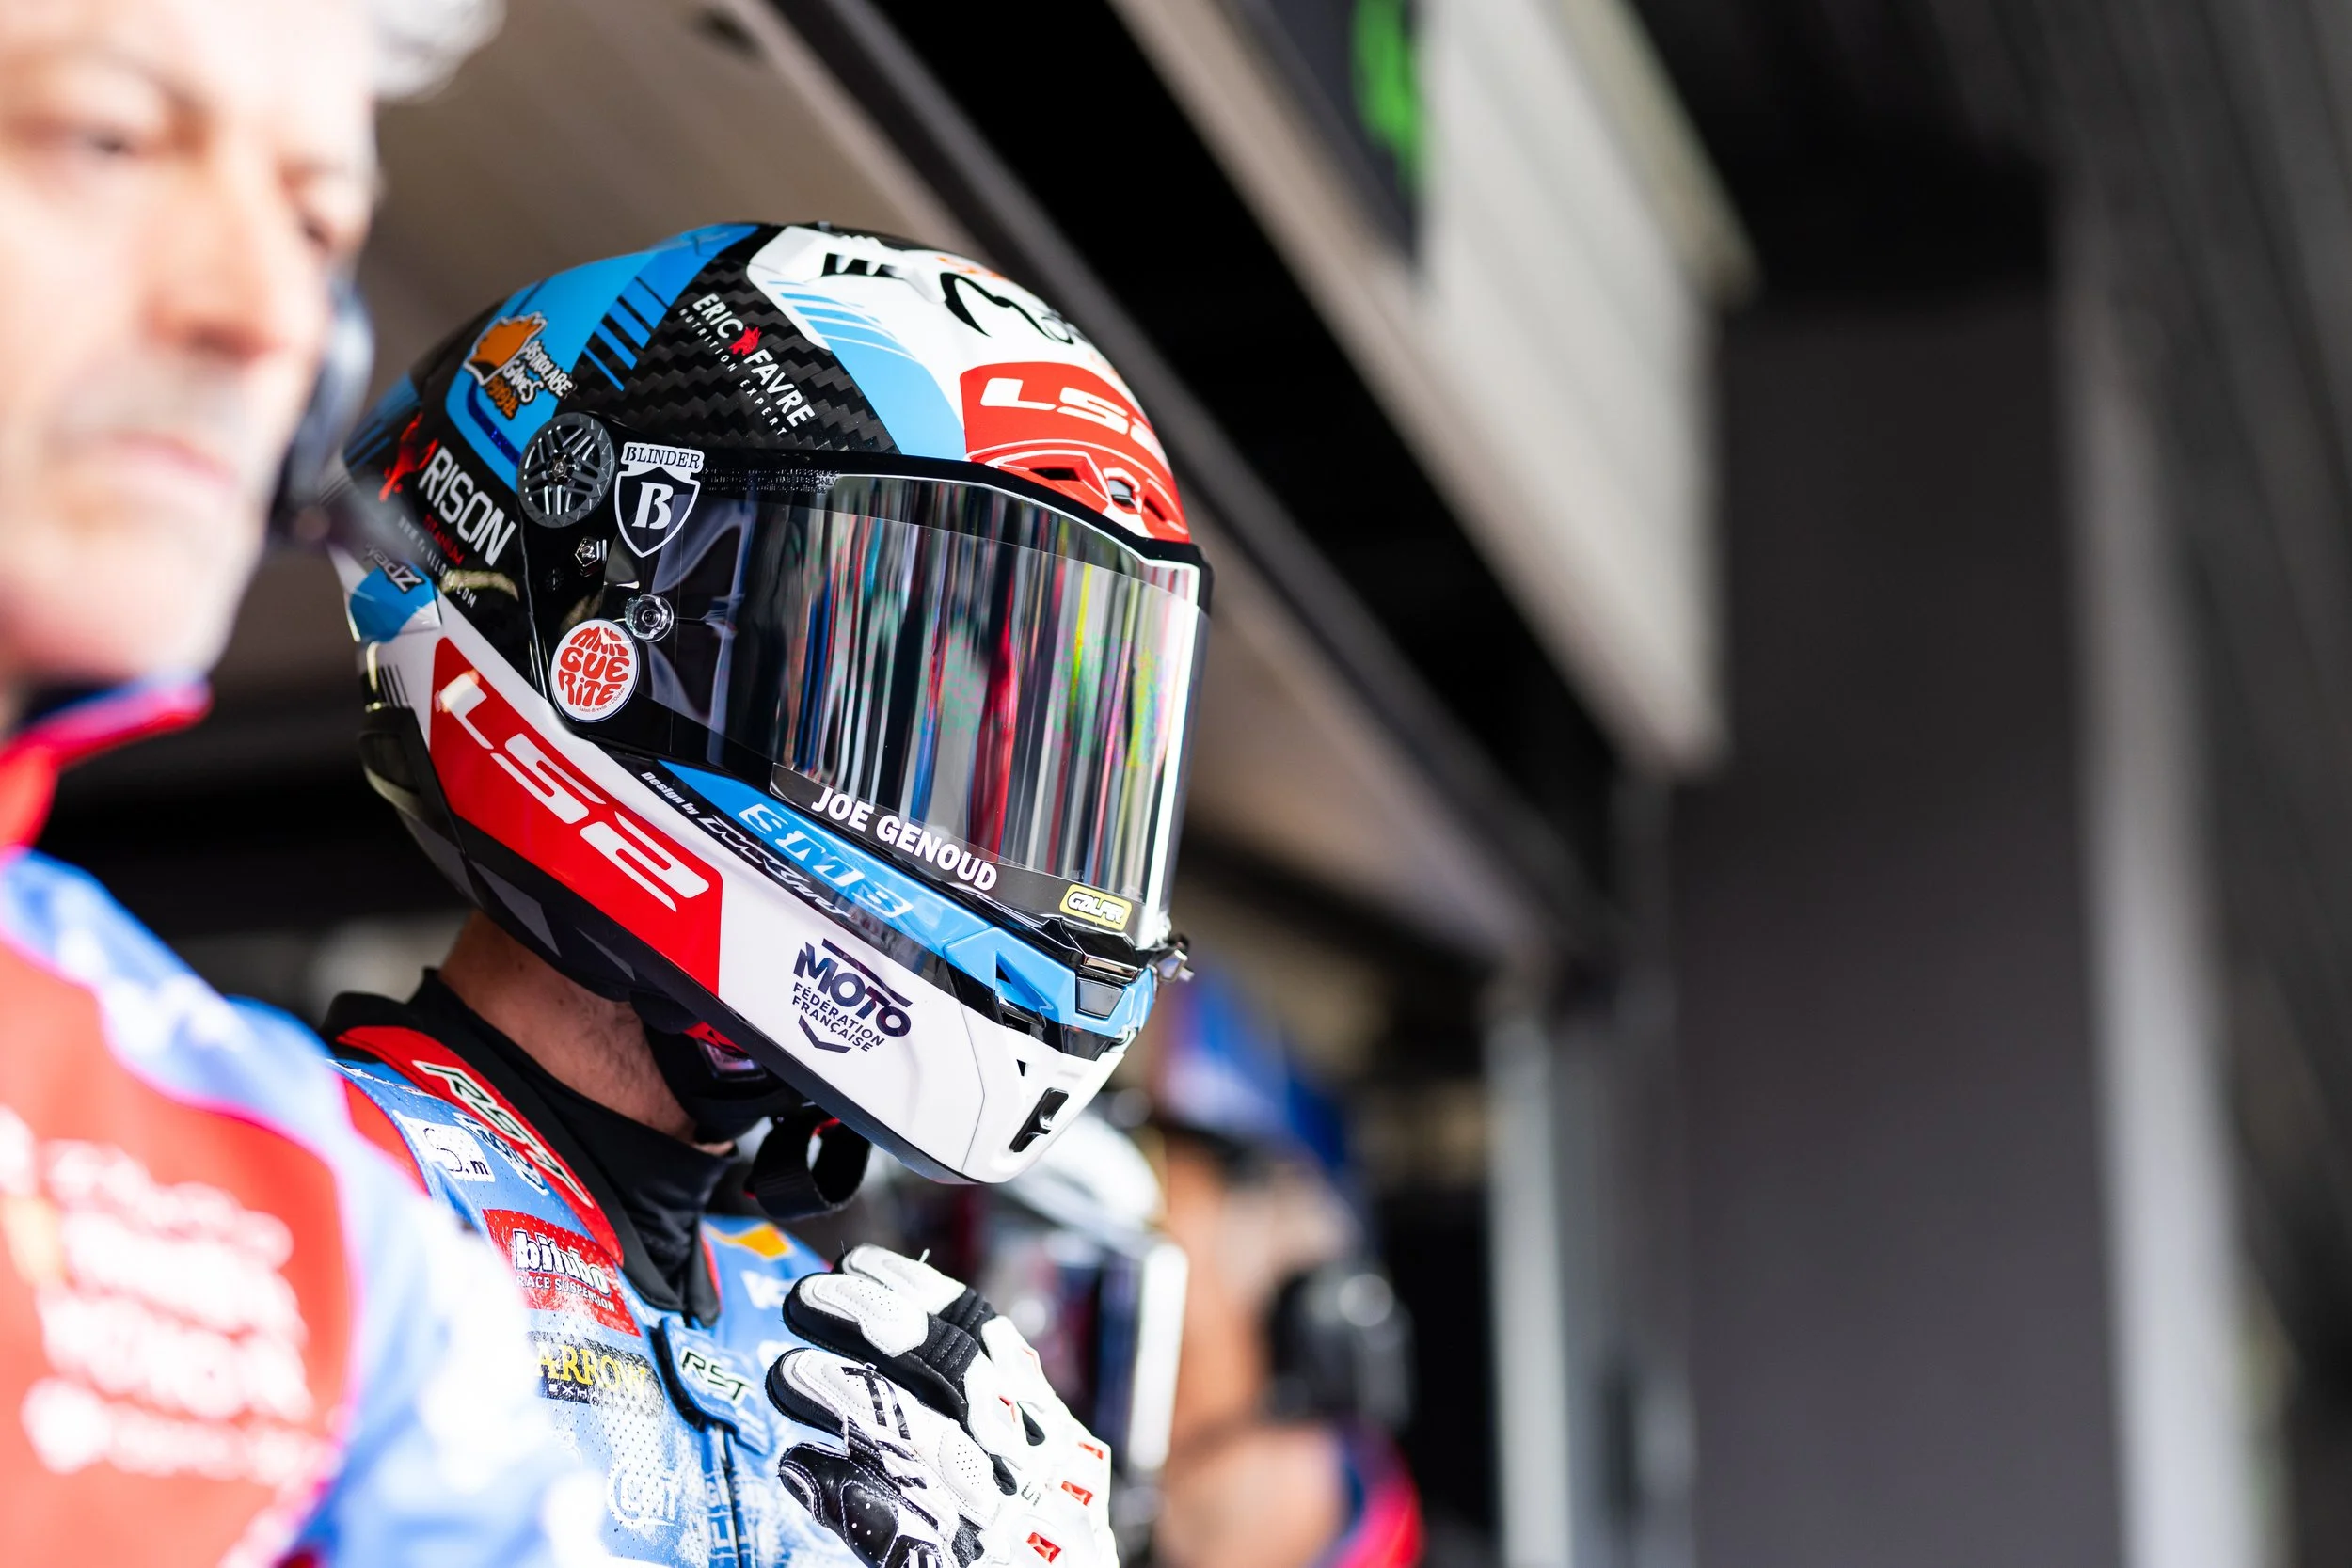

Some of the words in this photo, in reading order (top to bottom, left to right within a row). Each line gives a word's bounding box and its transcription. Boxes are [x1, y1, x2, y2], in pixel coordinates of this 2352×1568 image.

[502, 358, 544, 403] GAMES
[524, 341, 573, 397] ASTROLABE
[678, 308, 737, 372] NUTRITION
[739, 379, 787, 436] EXPERT
[692, 293, 744, 339] ERIC
[743, 349, 816, 427] FAVRE
[625, 446, 701, 469] BLINDER
[631, 481, 674, 530] B
[560, 647, 630, 683] GUE
[434, 664, 710, 913] LS2
[641, 772, 685, 804] Design
[681, 802, 700, 815] by
[811, 786, 874, 832] JOE
[876, 815, 997, 891] GENOUD
[793, 942, 912, 1037] MOTO
[793, 981, 885, 1046] FÉDÉRATION
[792, 995, 873, 1052] FRANÇAISE
[513, 1228, 612, 1296] bitubo
[516, 1275, 551, 1290] RACE
[554, 1278, 615, 1313] SUSPENSION
[679, 1349, 752, 1403] RST
